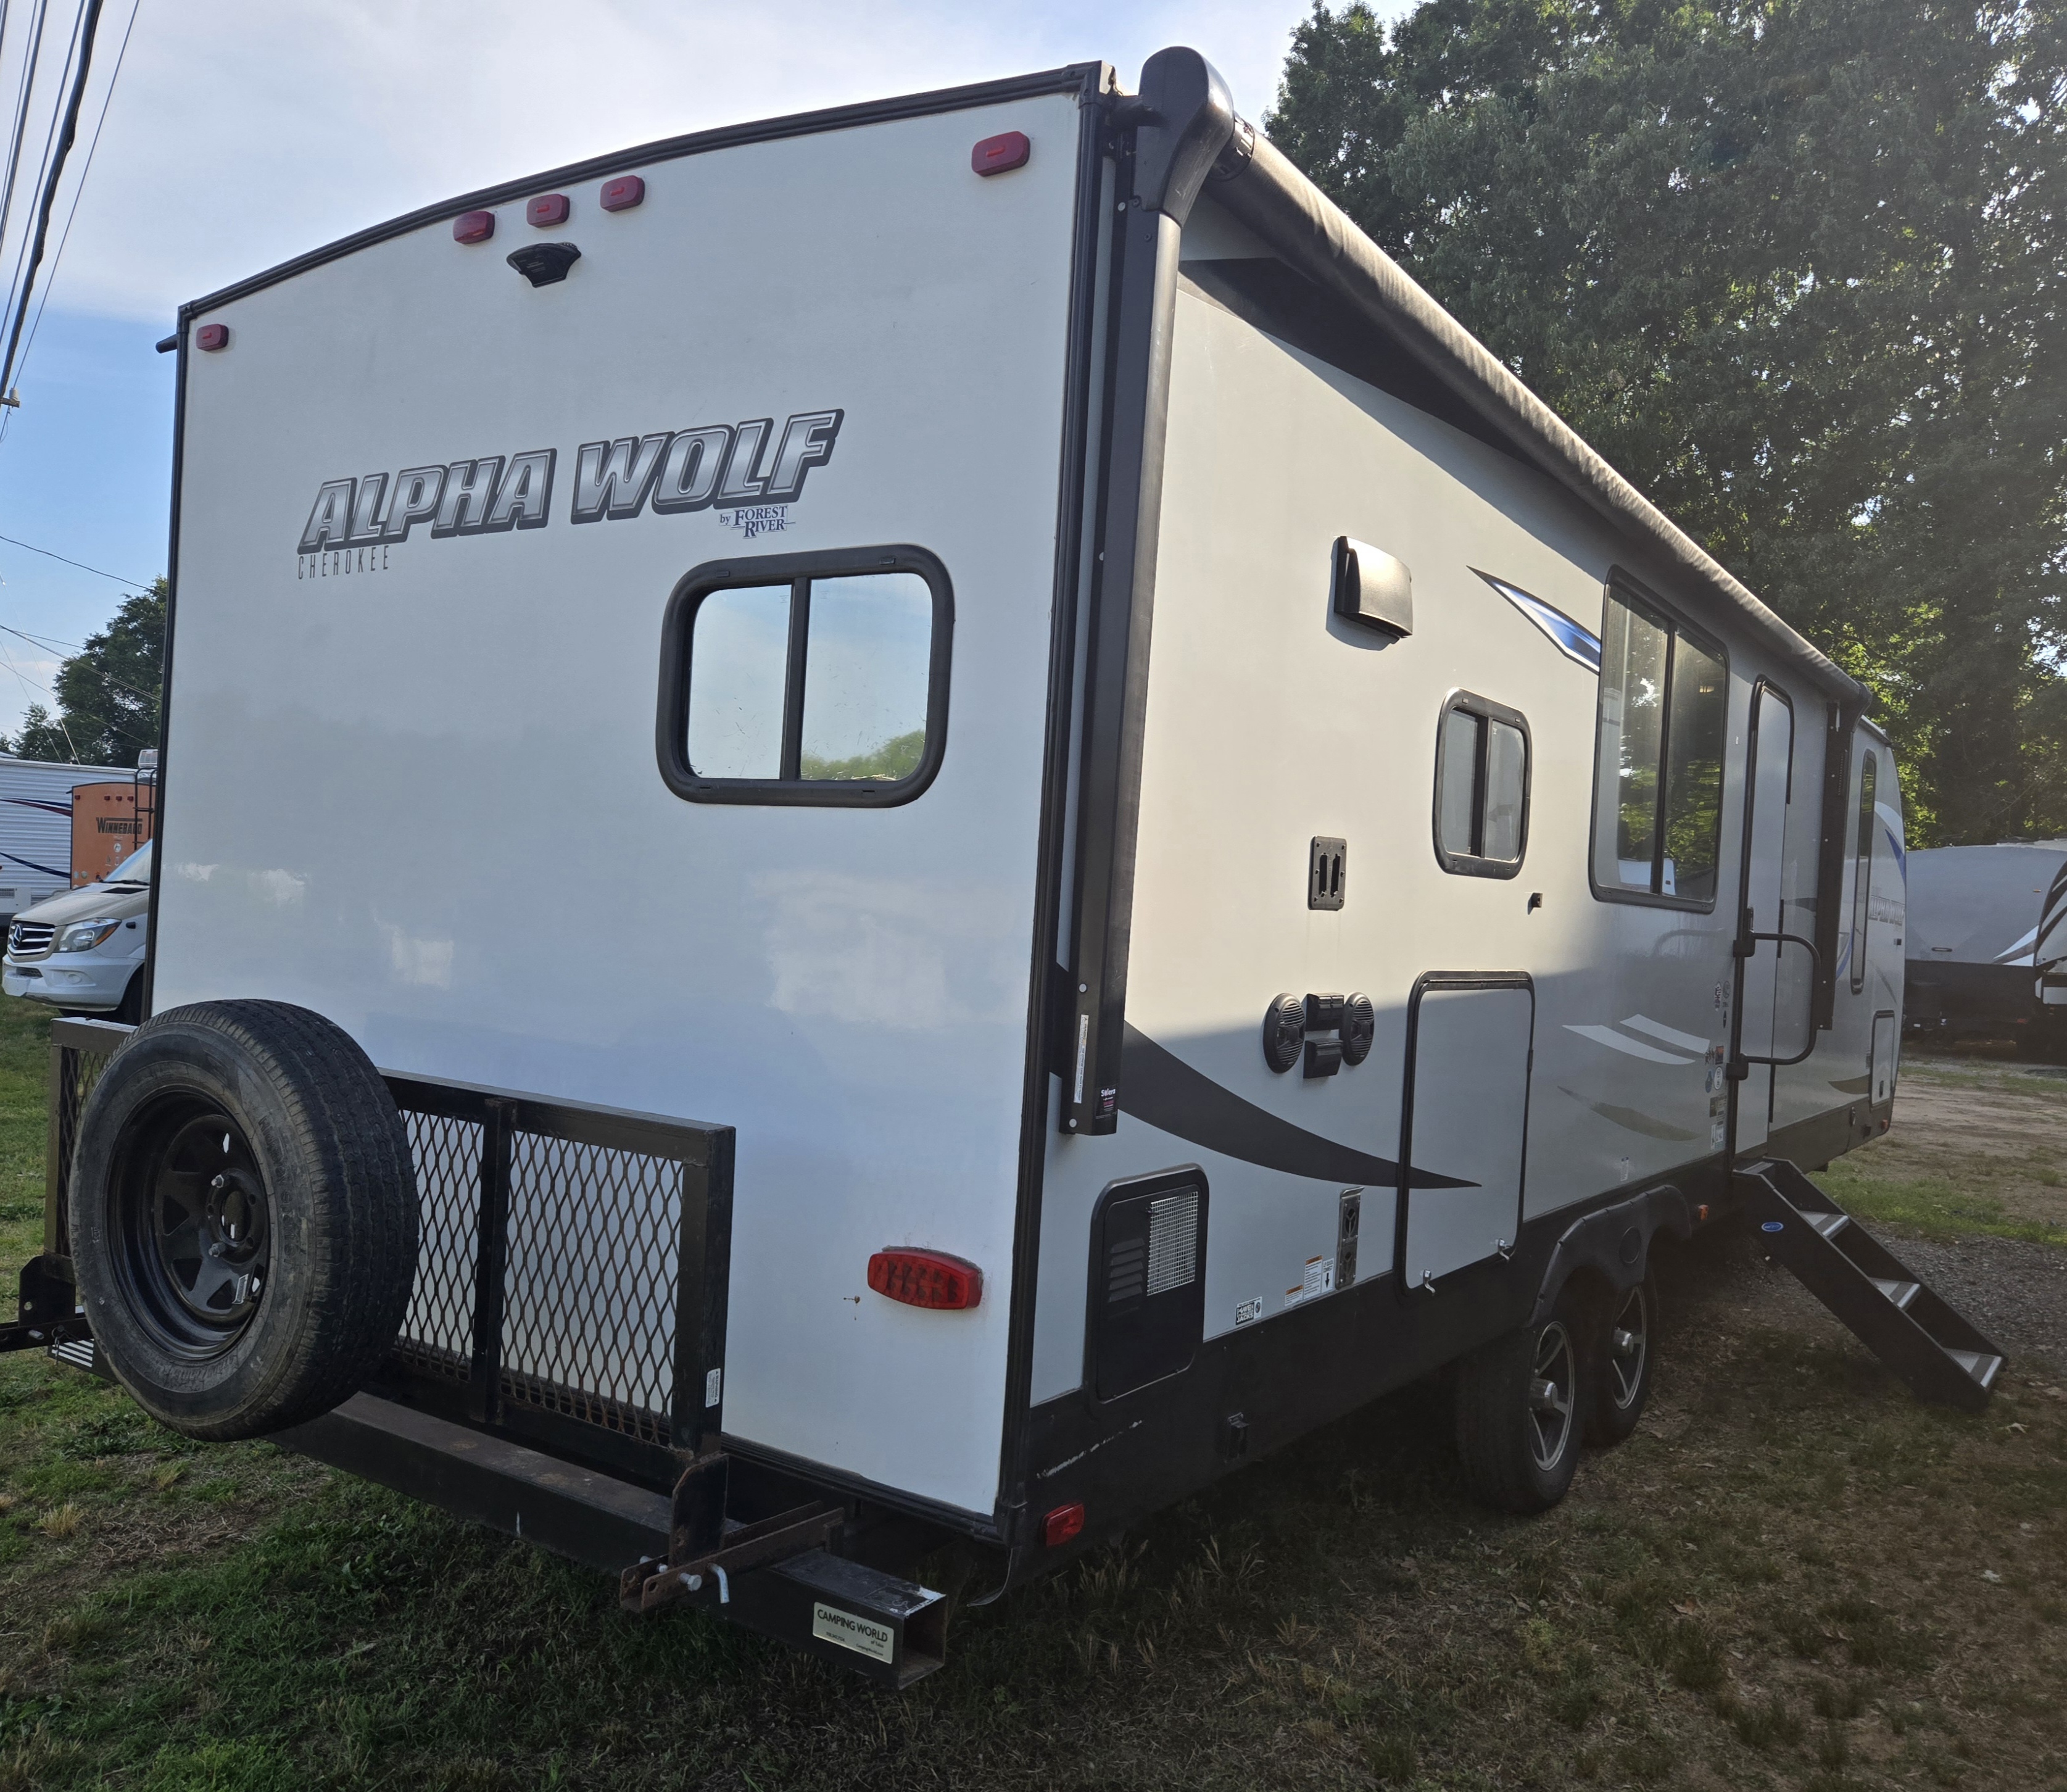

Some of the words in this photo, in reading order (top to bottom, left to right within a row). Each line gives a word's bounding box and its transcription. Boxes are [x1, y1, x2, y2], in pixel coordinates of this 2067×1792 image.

[297, 448, 557, 555] ALPHA
[570, 409, 845, 525] WOLF
[719, 514, 731, 525] by
[733, 505, 787, 526] FOREST
[743, 519, 785, 537] RIVER
[297, 545, 389, 579] CHEROKEE
[818, 1609, 855, 1631] CAMPING
[856, 1622, 888, 1642] WORLD
